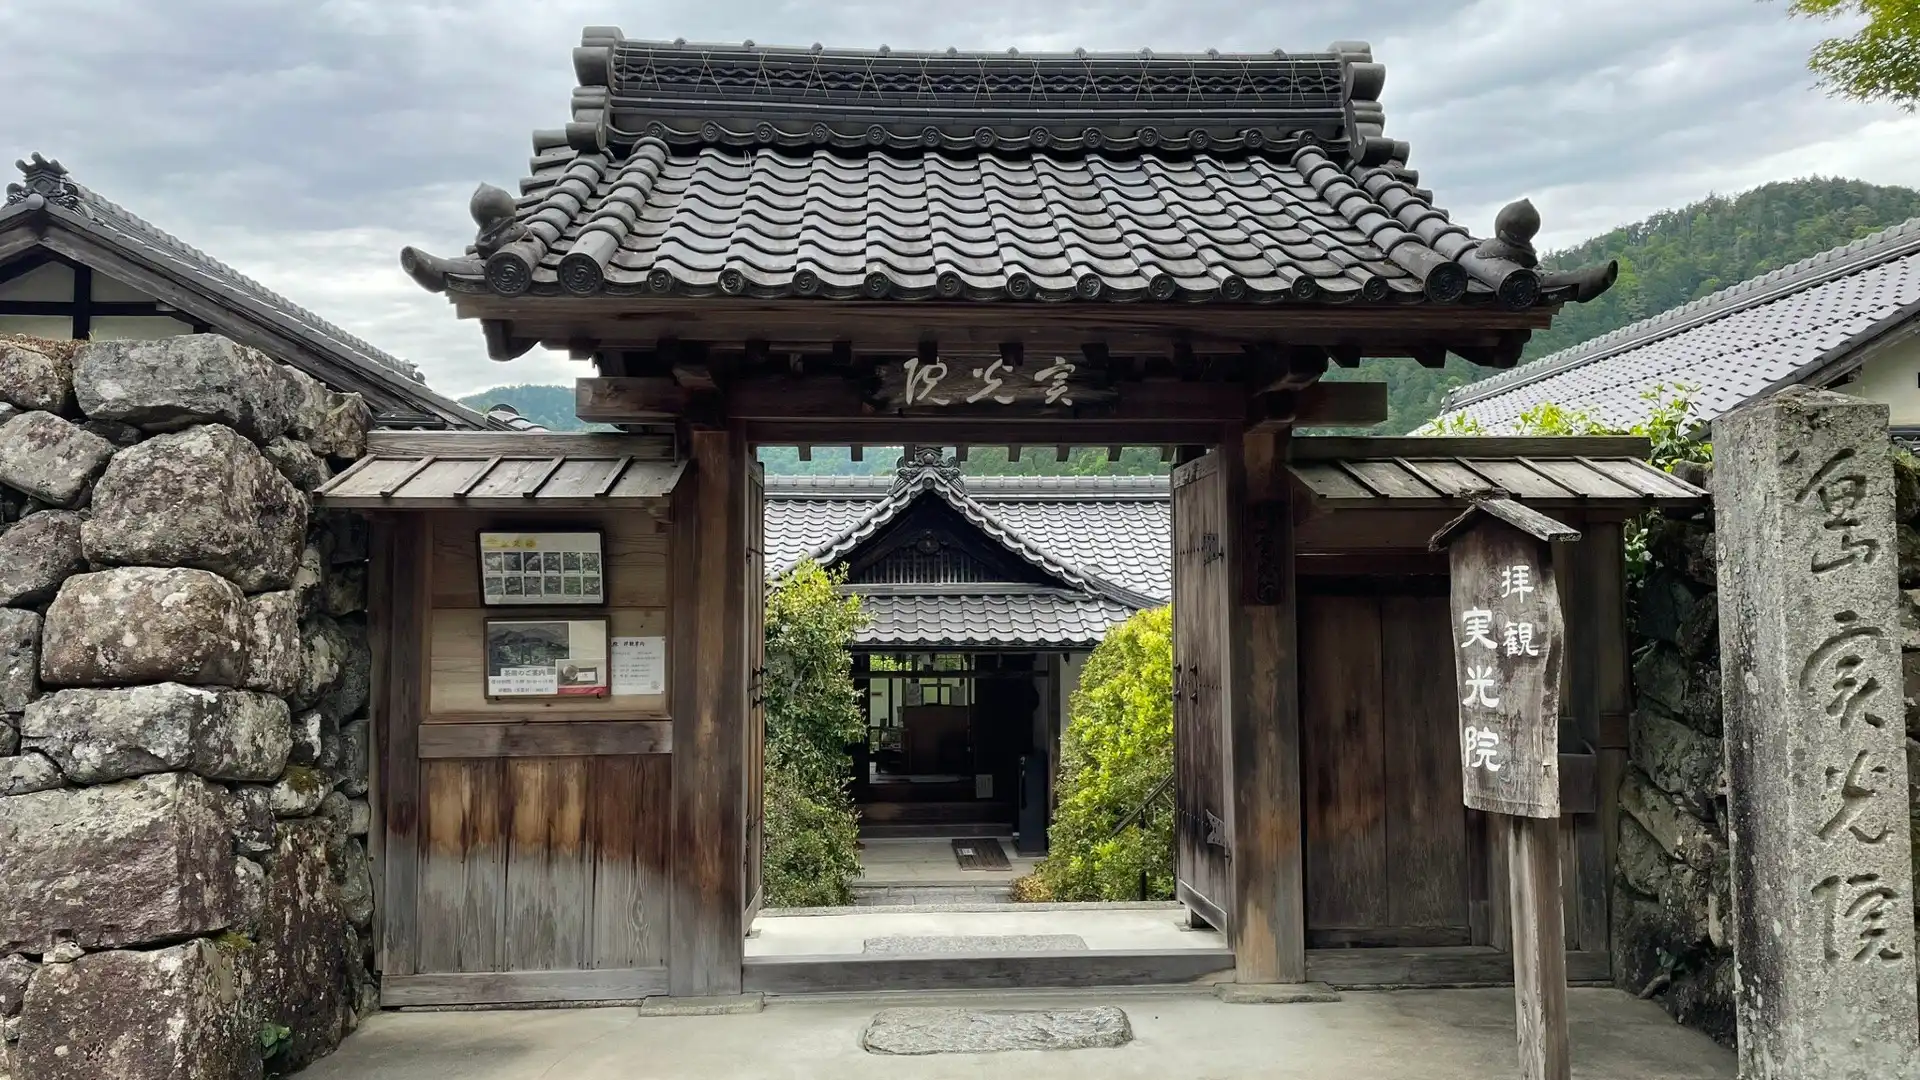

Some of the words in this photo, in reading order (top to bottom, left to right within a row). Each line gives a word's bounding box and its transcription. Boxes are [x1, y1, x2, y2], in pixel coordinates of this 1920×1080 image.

[1501, 565, 1539, 657] 拝観
[1461, 606, 1502, 772] 実光院
